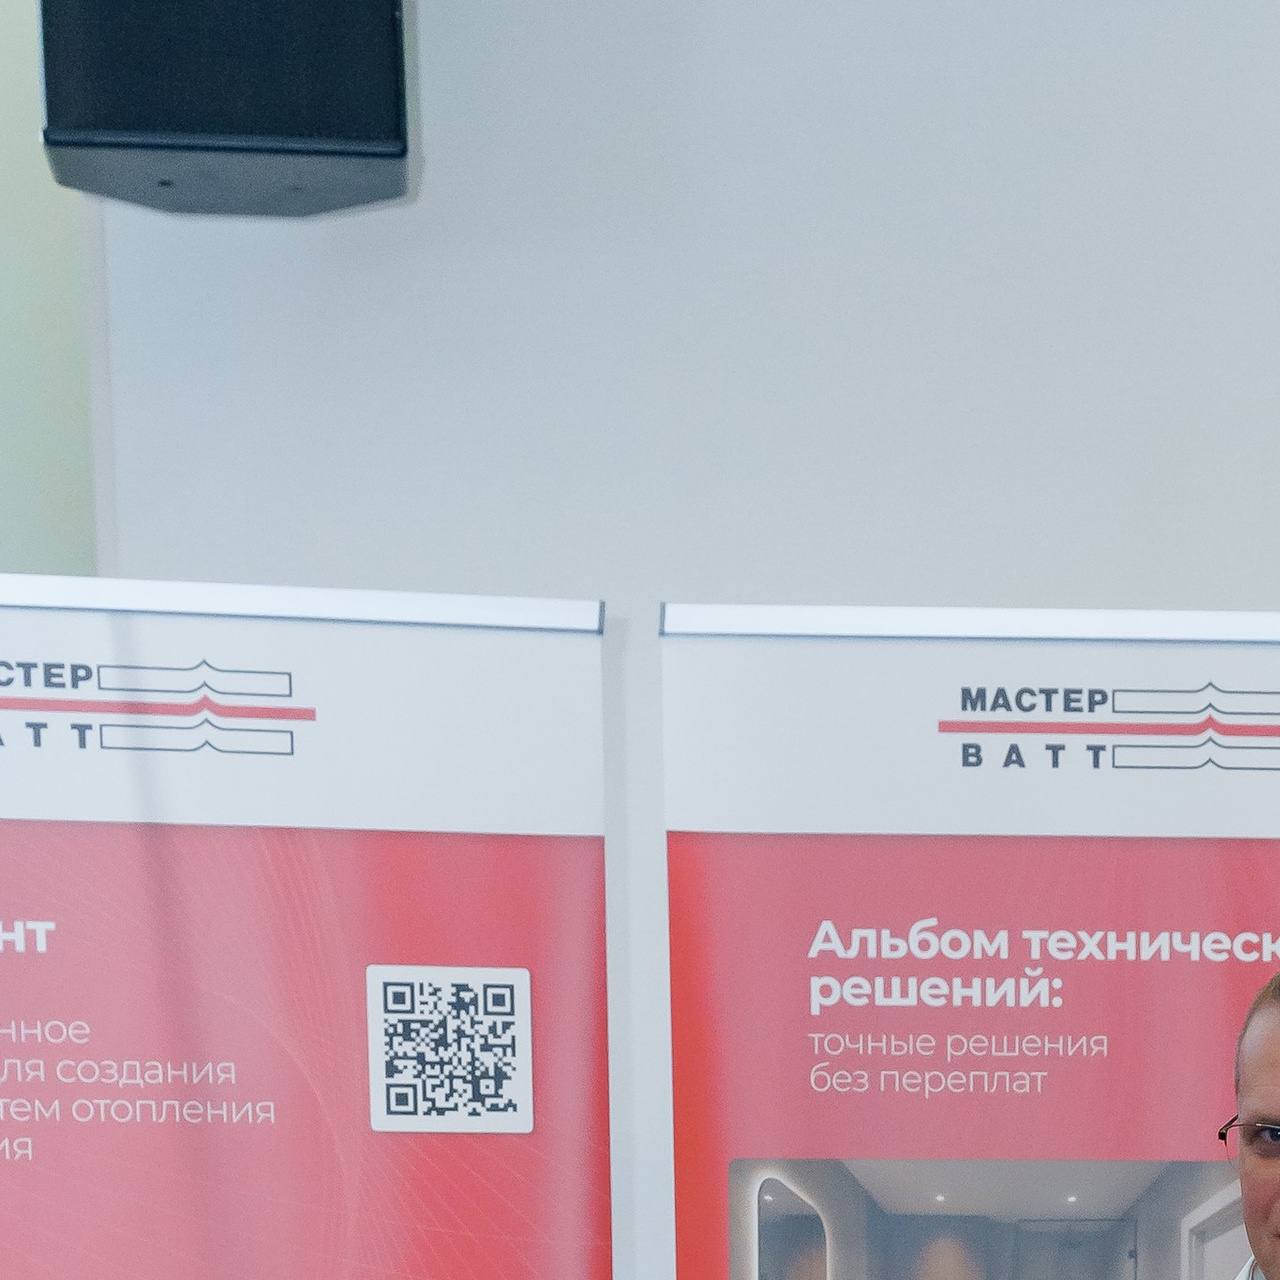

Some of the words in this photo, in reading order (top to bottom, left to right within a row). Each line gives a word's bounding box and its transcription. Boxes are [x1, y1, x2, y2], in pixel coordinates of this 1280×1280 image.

[961, 687, 1108, 713] МАСТЕР
[962, 743, 1106, 769] ВАТТ
[808, 918, 1008, 960] Альбом
[810, 968, 1063, 1015] решений:
[808, 1031, 936, 1056] точные
[946, 1032, 1108, 1062] решения
[56, 1060, 237, 1088] создания
[809, 1062, 868, 1092] без
[879, 1068, 1048, 1098] переплат
[71, 1098, 275, 1125] отопления
